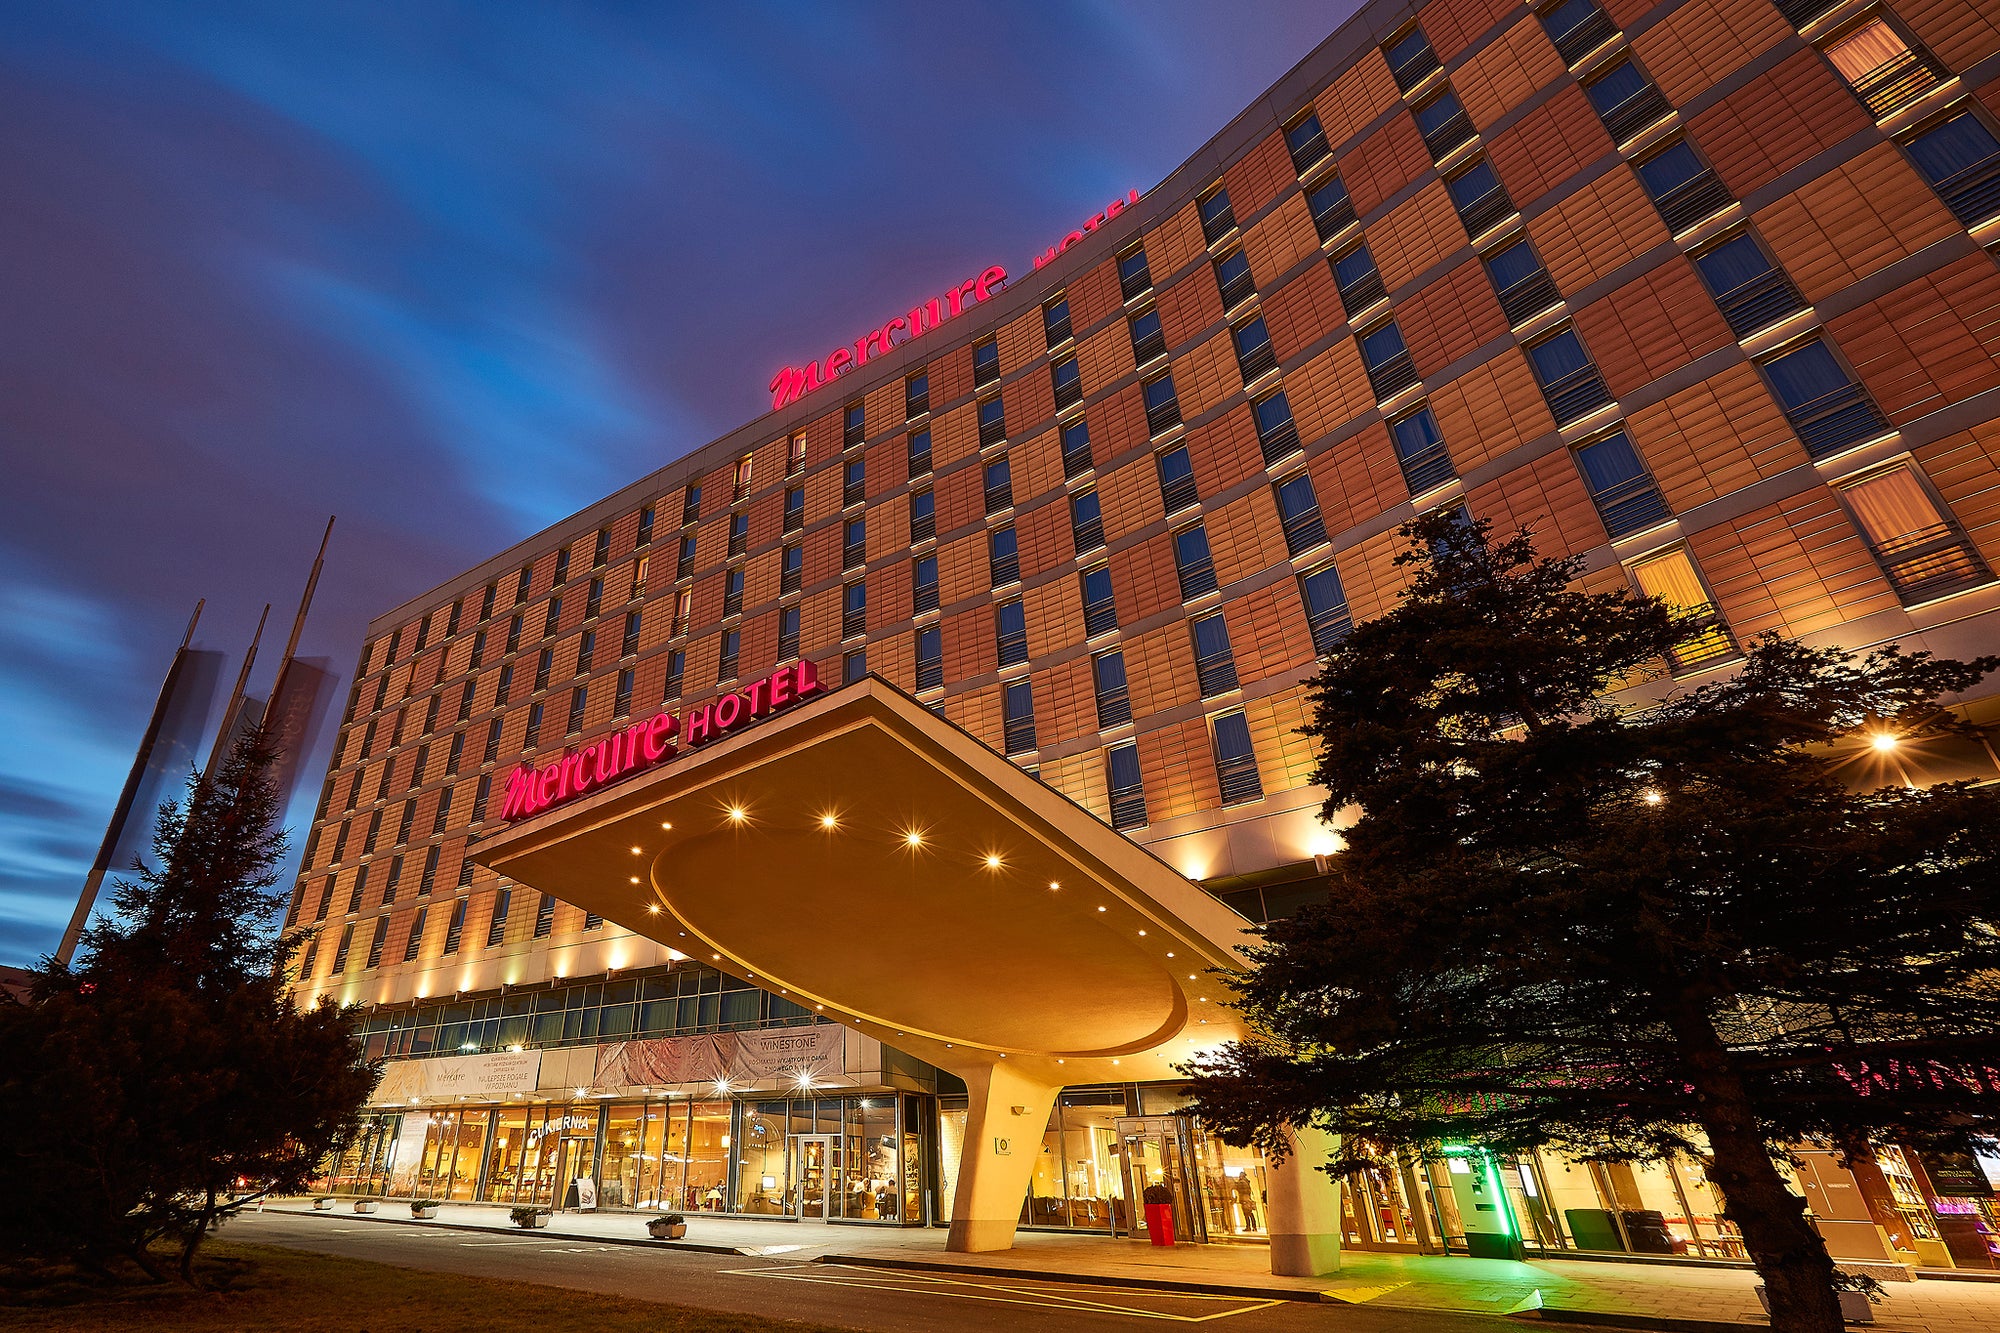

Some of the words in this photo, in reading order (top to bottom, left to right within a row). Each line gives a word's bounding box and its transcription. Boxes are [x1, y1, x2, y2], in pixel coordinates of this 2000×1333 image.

[687, 659, 828, 748] HOTEL
[760, 1038, 816, 1050] WINESTONE
[530, 1115, 589, 1141] CUKIERNIA
